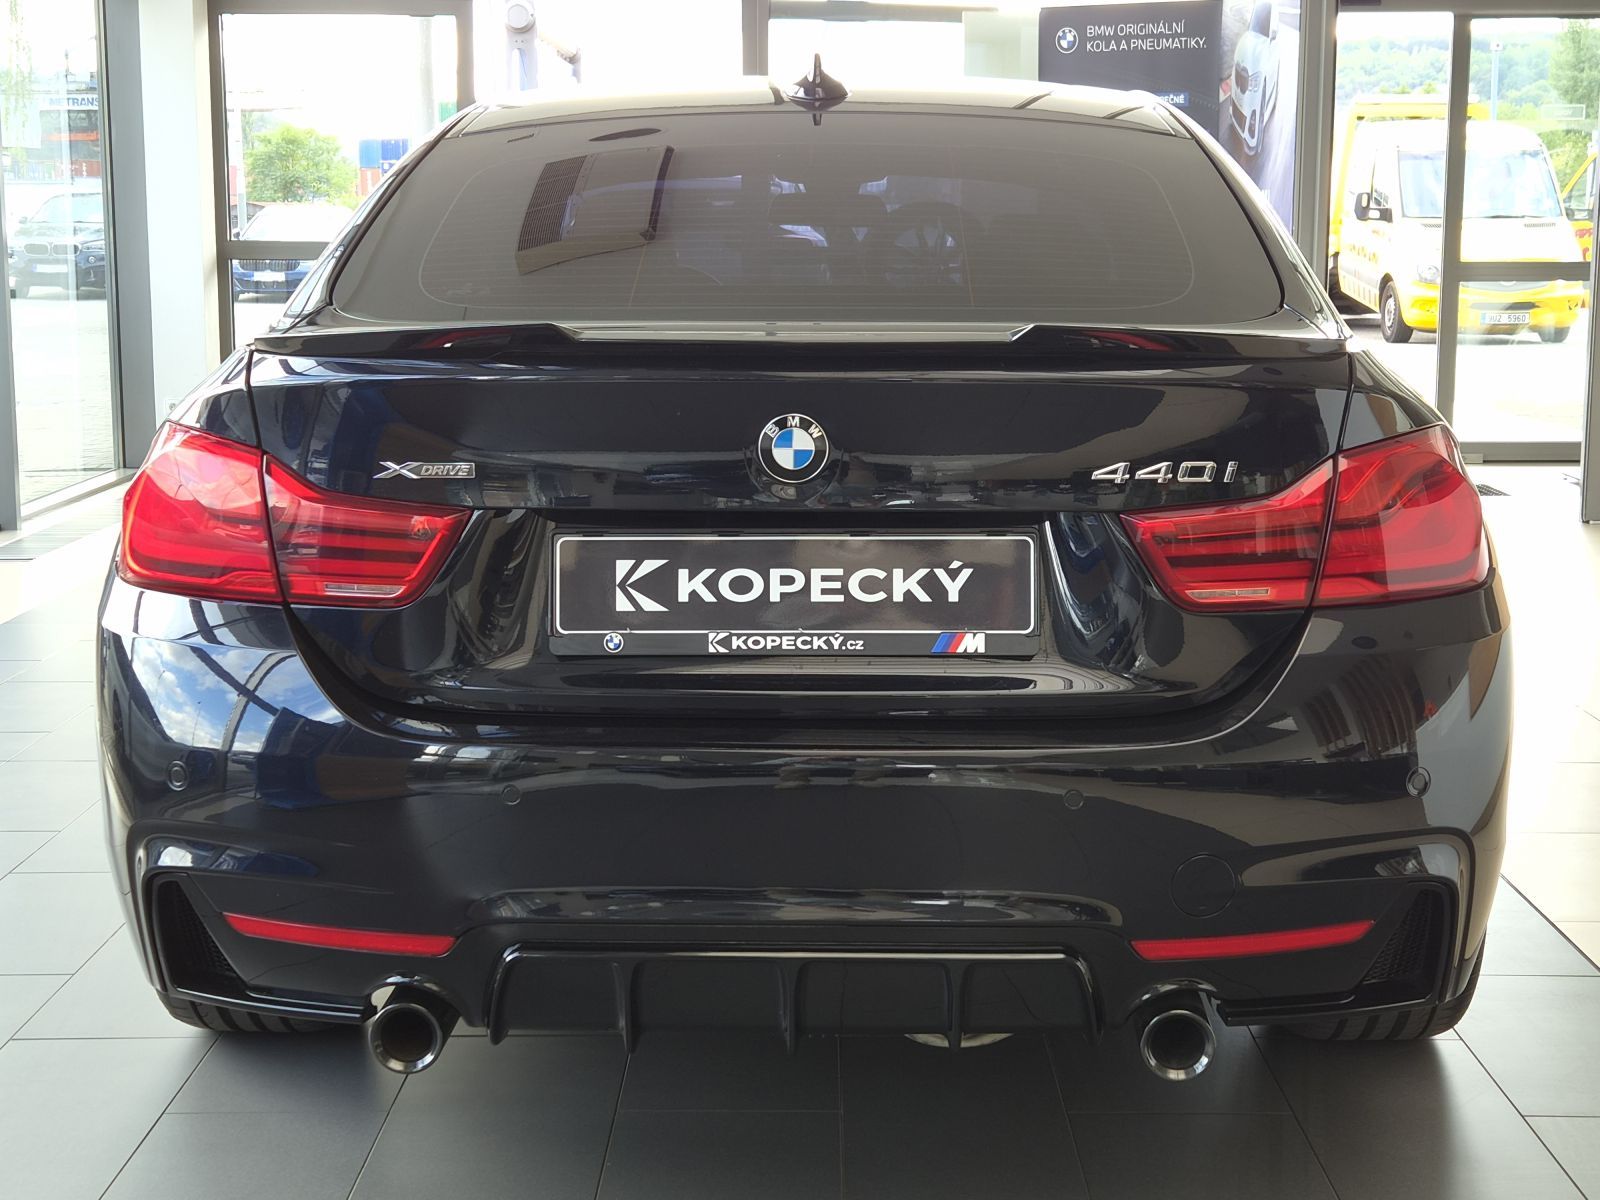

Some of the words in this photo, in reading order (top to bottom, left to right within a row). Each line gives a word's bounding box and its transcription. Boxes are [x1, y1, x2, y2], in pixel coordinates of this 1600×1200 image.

[1086, 25, 1115, 37] BMW
[1117, 19, 1185, 36] ORIGINÁLNÍ
[1086, 39, 1117, 52] KOLA
[1119, 40, 1128, 51] A
[1130, 36, 1207, 51] PNEUMATIKY.
[765, 415, 823, 439] BMW
[1091, 461, 1239, 484] 440i
[677, 560, 974, 603] KOPECKÝ
[731, 633, 864, 651] KOPECKÝ.cz
